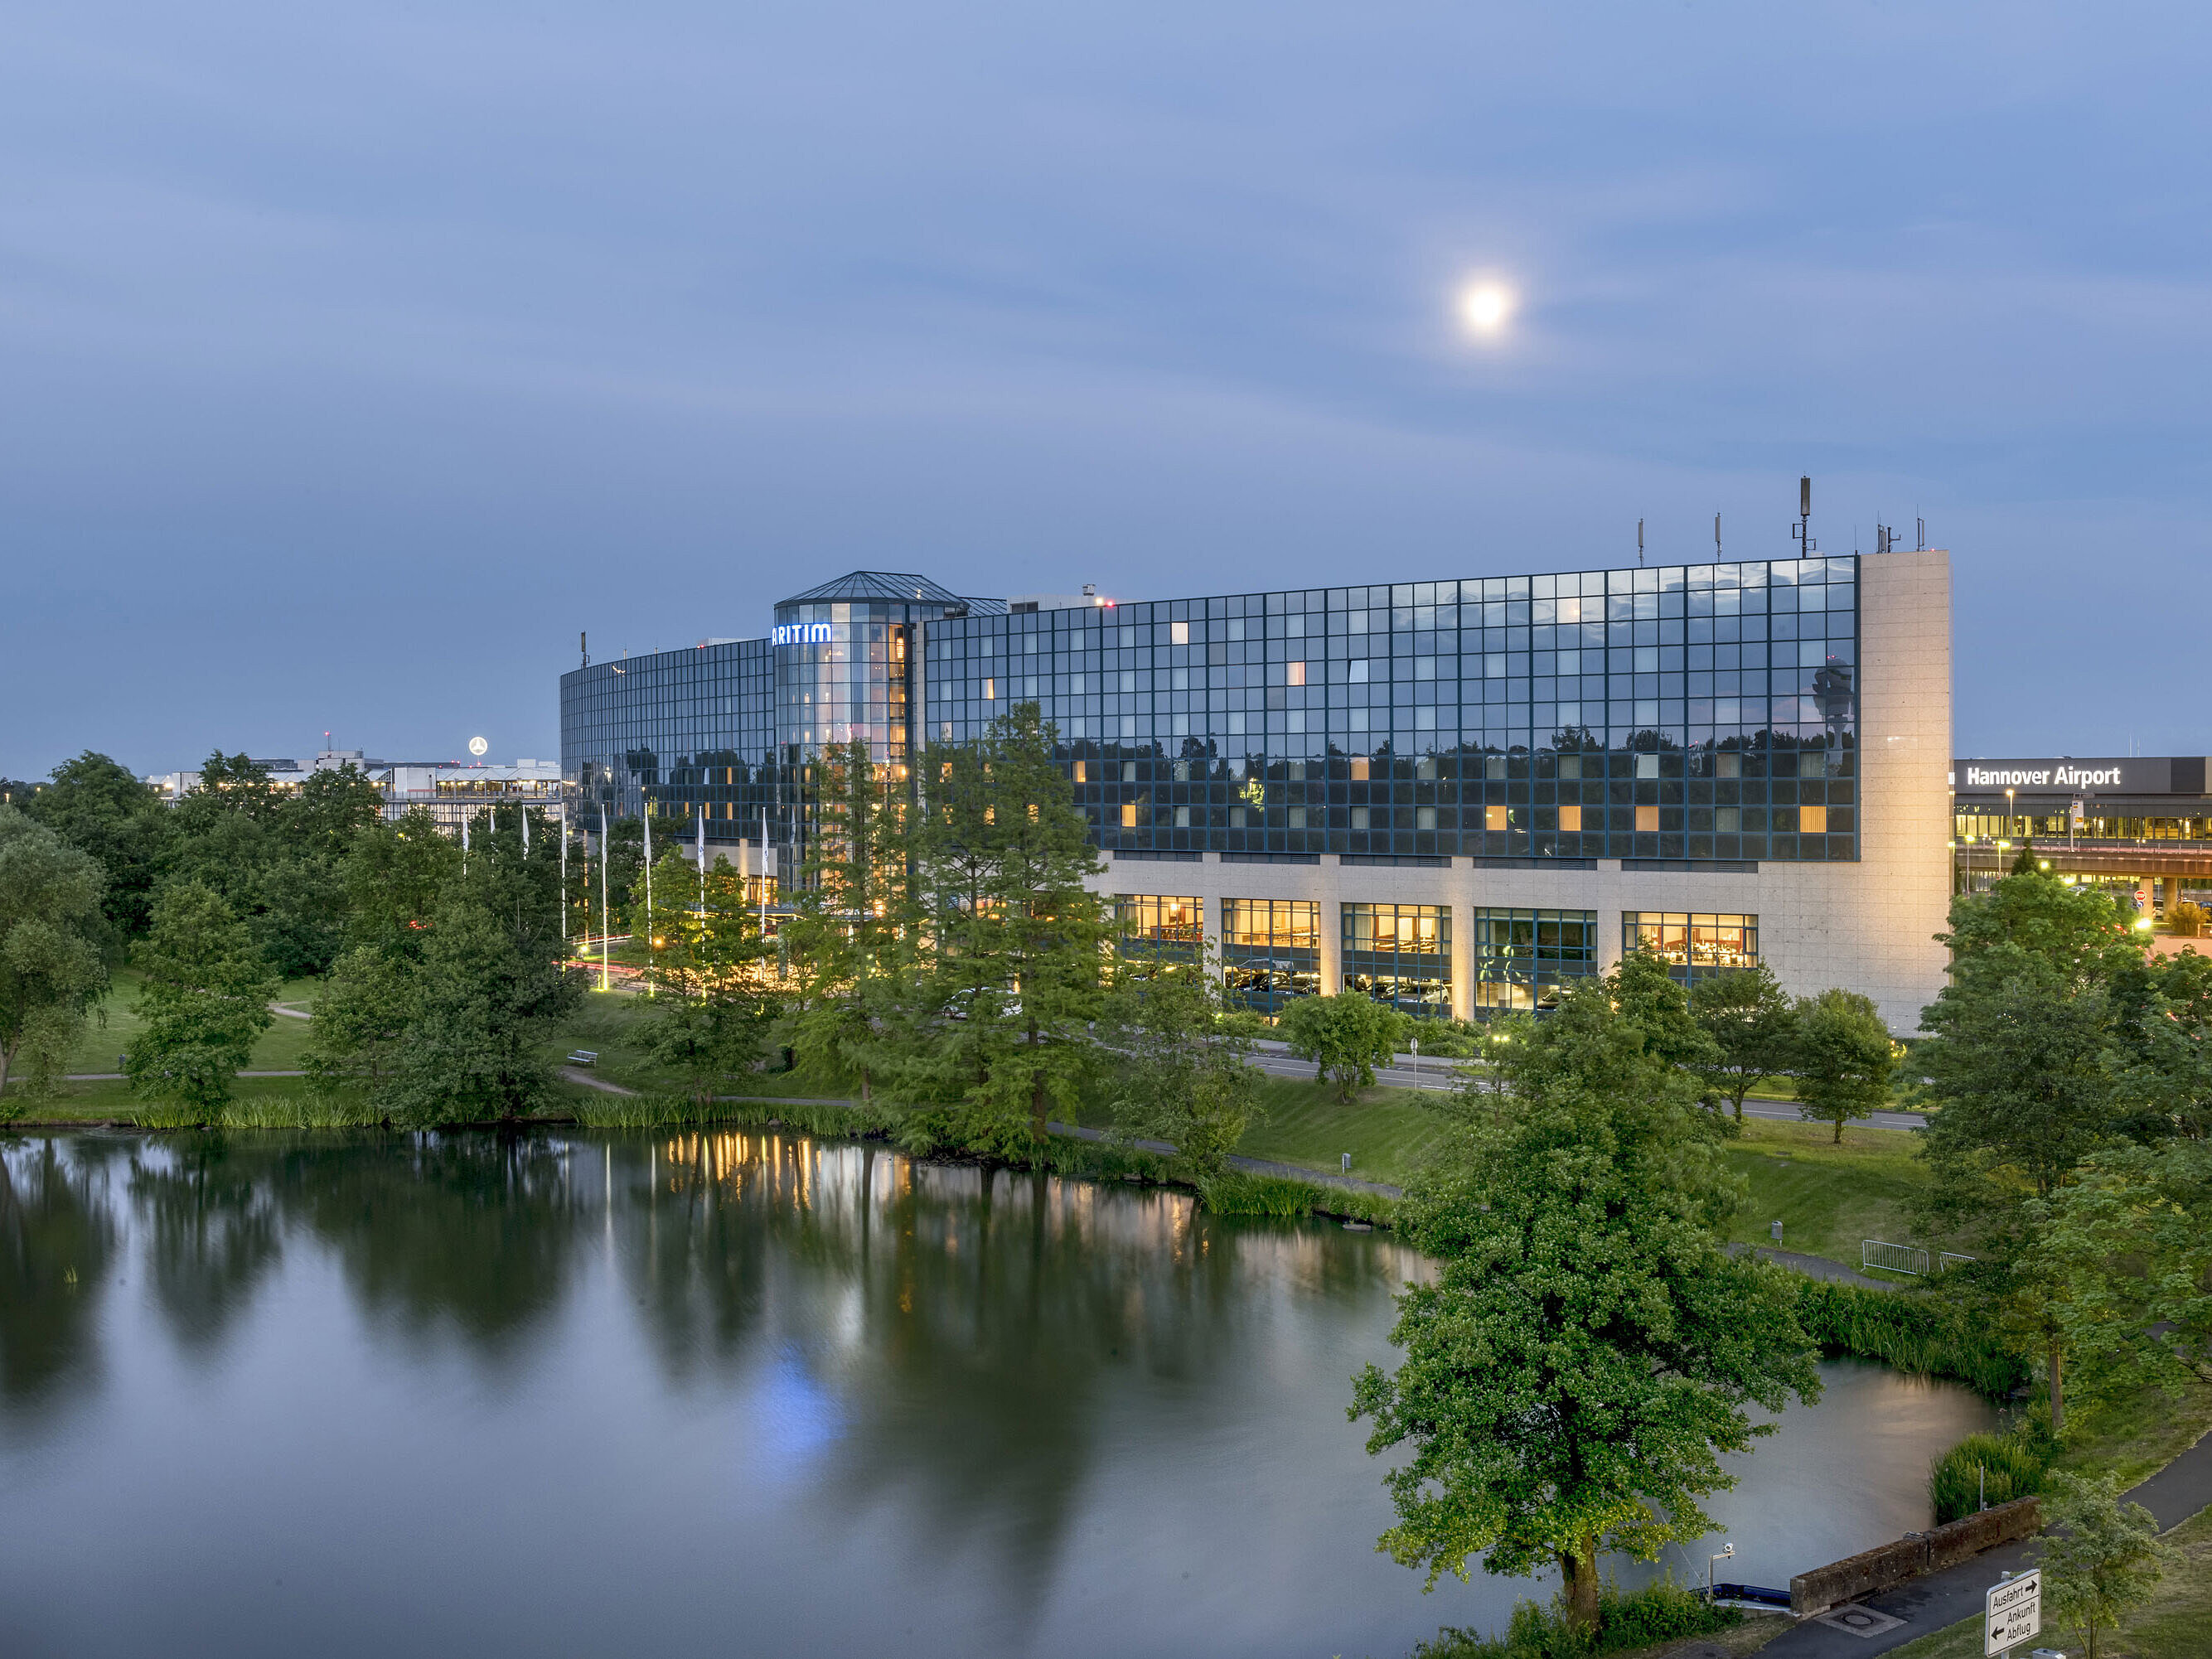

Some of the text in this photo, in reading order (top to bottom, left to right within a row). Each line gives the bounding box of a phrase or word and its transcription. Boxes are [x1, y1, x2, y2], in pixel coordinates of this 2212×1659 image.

[1968, 766, 2121, 790] Hannover Airport
[1993, 1585, 2023, 1609] Ausfahrt
[2006, 1602, 2035, 1624] Ankunft
[2006, 1623, 2030, 1641] Abflug
